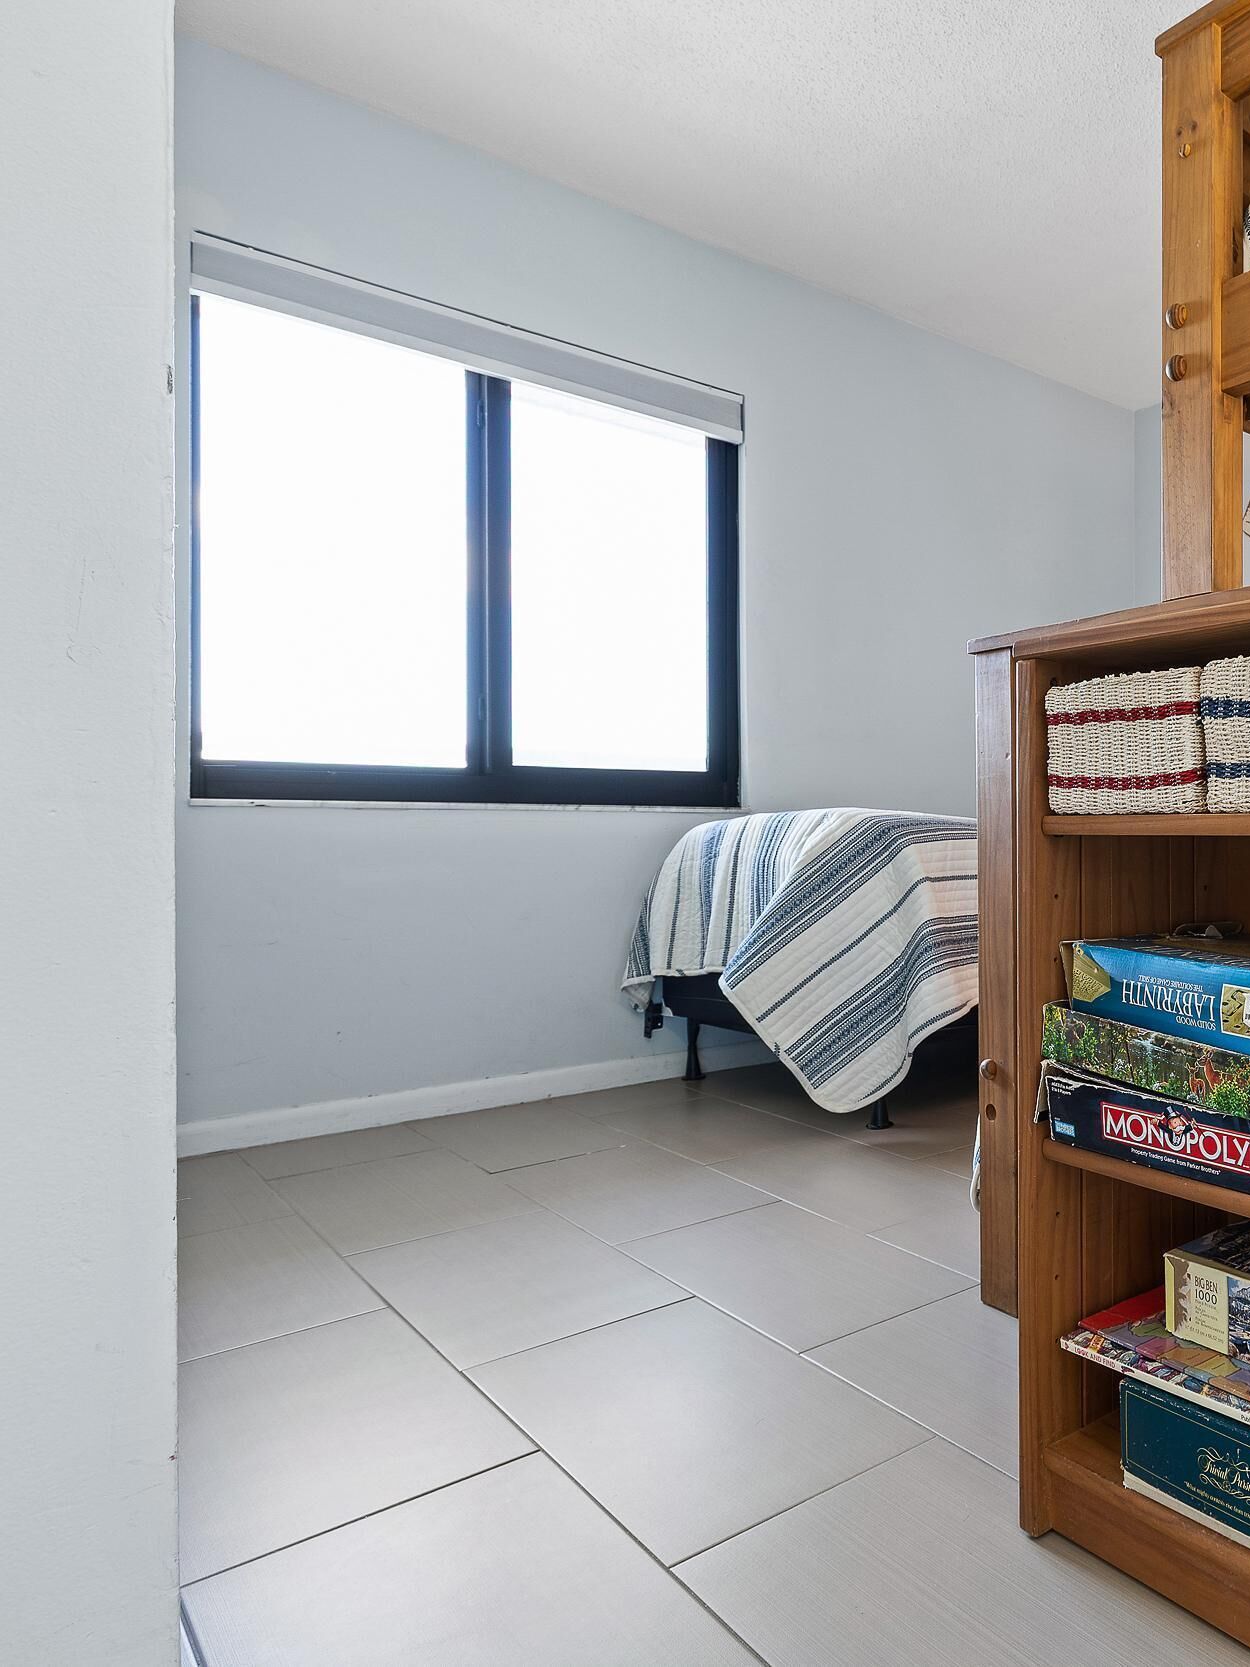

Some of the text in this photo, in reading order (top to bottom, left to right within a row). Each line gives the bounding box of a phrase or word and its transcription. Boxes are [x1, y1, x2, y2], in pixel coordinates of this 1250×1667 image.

[1122, 979, 1215, 1021] LABYRINTH
[1176, 1015, 1197, 1026] WOOD
[1105, 1108, 1250, 1166] MONOPOLY
[1131, 1148, 1148, 1158] Property
[1149, 1151, 1163, 1161] Trading
[1164, 1156, 1176, 1164] Game
[1187, 1161, 1200, 1170] Parker
[1194, 1276, 1218, 1294] BIG BEN
[1195, 1289, 1218, 1305] 1000
[1074, 1347, 1115, 1368] LOOK AND FIND
[1204, 1460, 1230, 1480] Trivial
